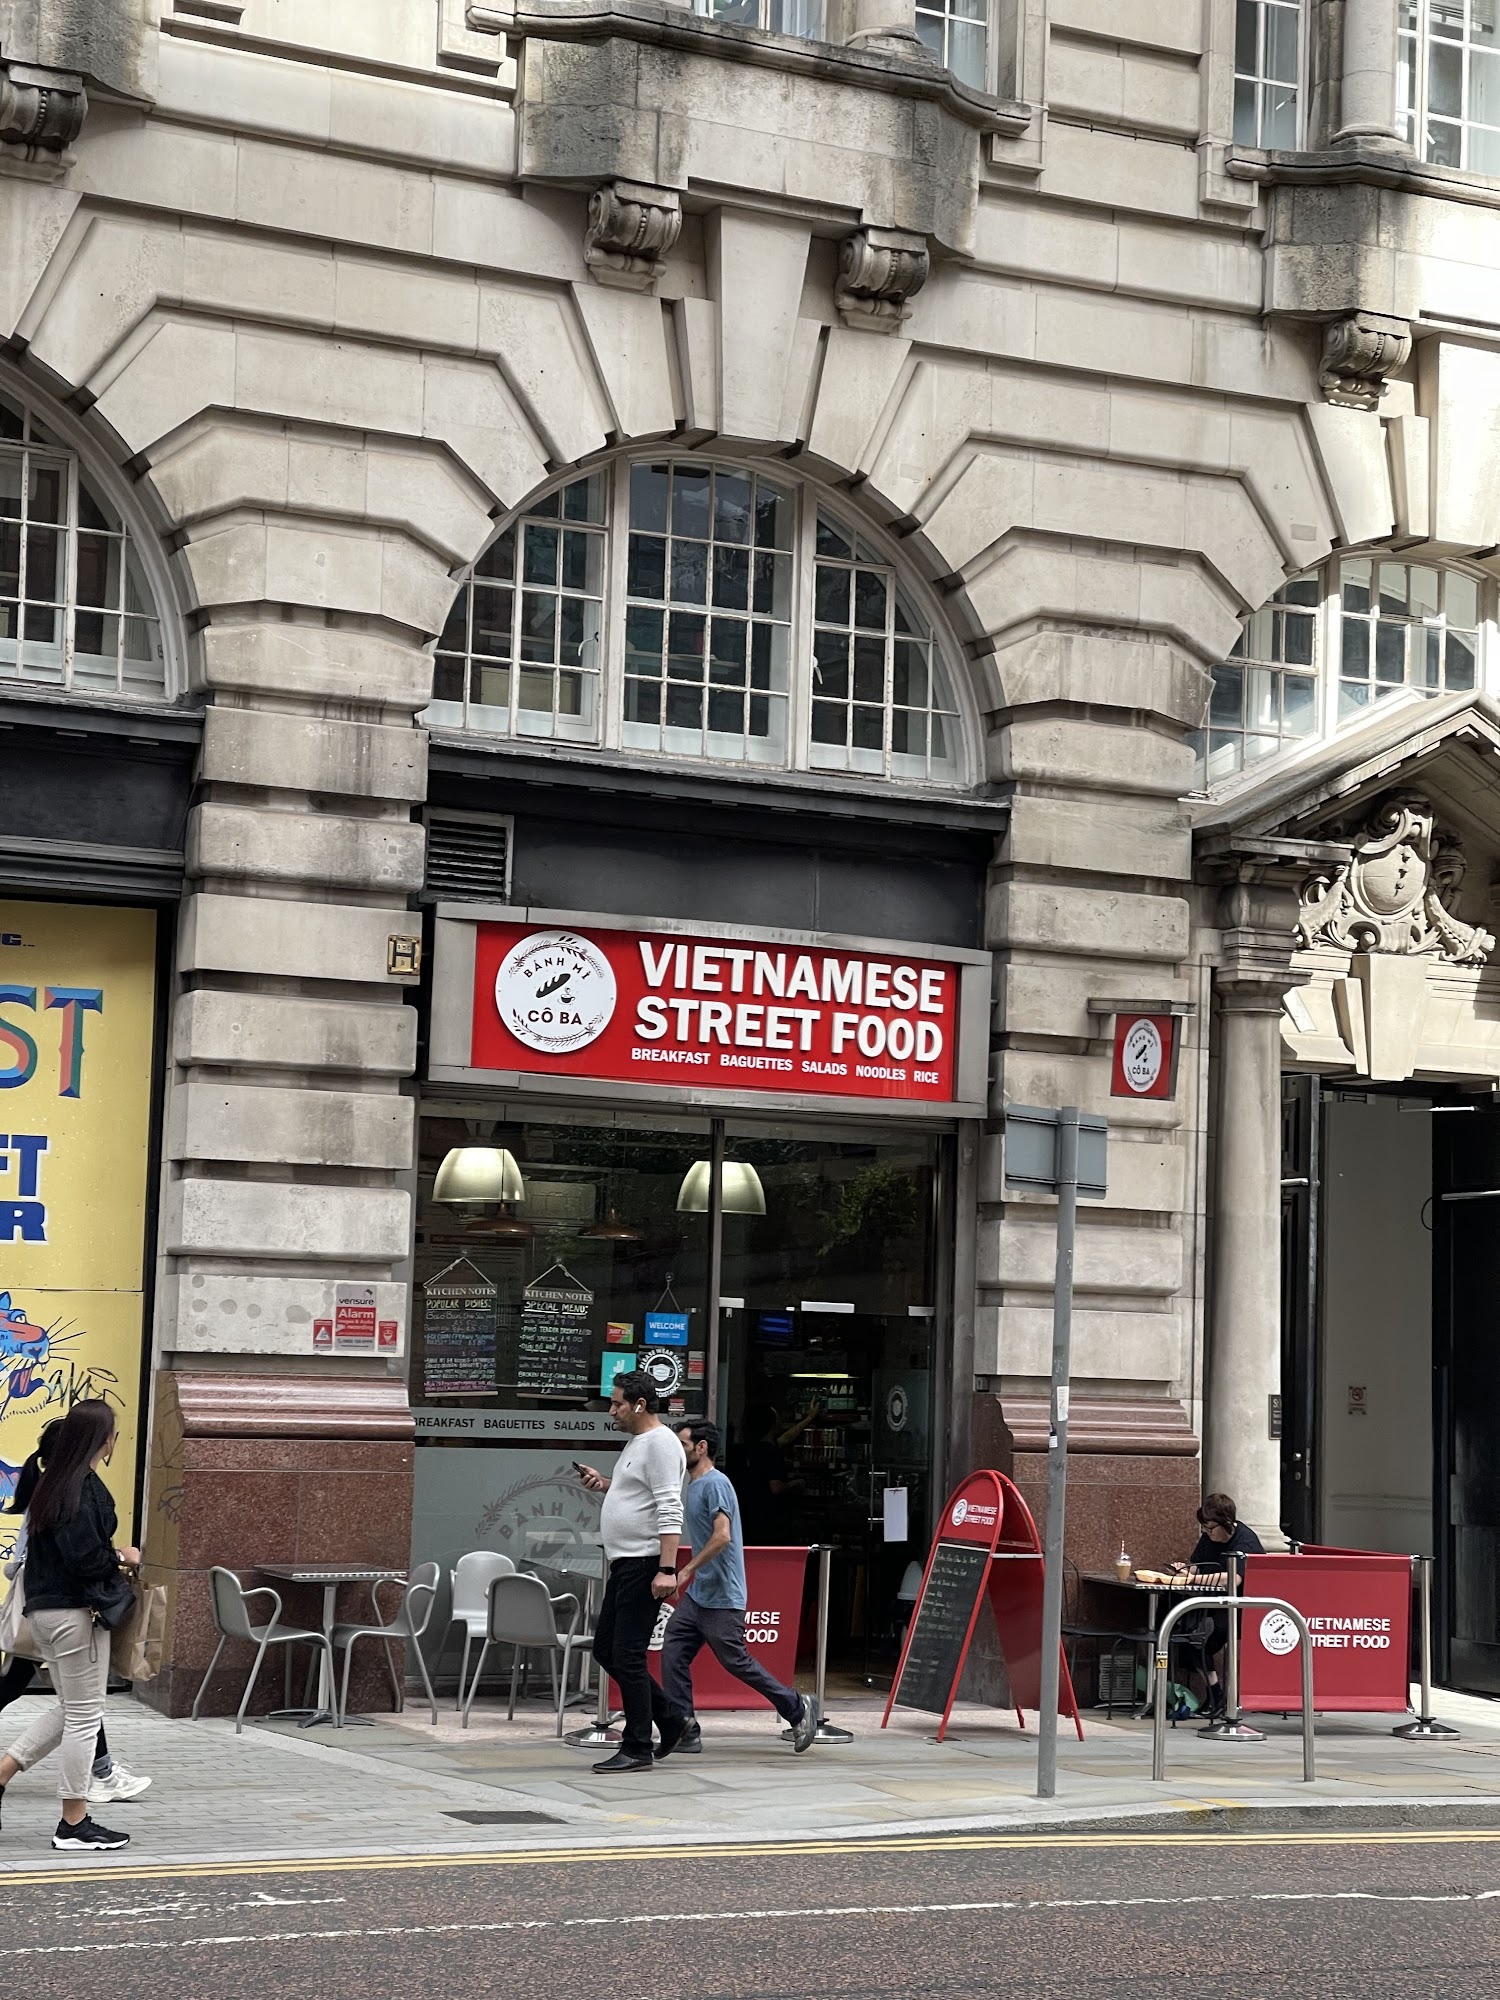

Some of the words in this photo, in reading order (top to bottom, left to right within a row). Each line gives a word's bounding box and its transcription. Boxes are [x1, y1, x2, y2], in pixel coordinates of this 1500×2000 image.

[639, 941, 945, 1013] VIETNAMESE
[528, 1007, 554, 1023] CÔ
[560, 1012, 582, 1025] BA
[634, 995, 821, 1051] STREET
[832, 1012, 943, 1062] FOOD
[631, 1048, 711, 1065] BREAKFAST
[720, 1054, 793, 1071] BAGUETTES
[801, 1060, 847, 1076] SALADS
[856, 1065, 906, 1081] NOODLES
[913, 1070, 939, 1084] RICE
[1142, 1067, 1150, 1075] BA
[426, 1287, 466, 1296] KITCHEN
[468, 1287, 496, 1296] NOTES
[524, 1290, 563, 1299] KITCHEN
[564, 1293, 593, 1301] NOTES
[426, 1299, 459, 1308] POPULAR
[524, 1301, 559, 1310] SPECIAL
[338, 1308, 374, 1319] Alarm
[649, 1322, 685, 1330] WELCOME
[639, 1350, 656, 1370] PLEASE
[656, 1348, 674, 1357] WEAR
[672, 1354, 684, 1373] MASK
[483, 1419, 545, 1430] BAGUETTES
[553, 1420, 595, 1431] SALADS
[967, 1504, 998, 1515] VIETNAMESE
[964, 1514, 982, 1523] STREET
[981, 1516, 995, 1526] FOOD
[1310, 1635, 1351, 1648] TREET
[1352, 1635, 1390, 1648] FOOD
